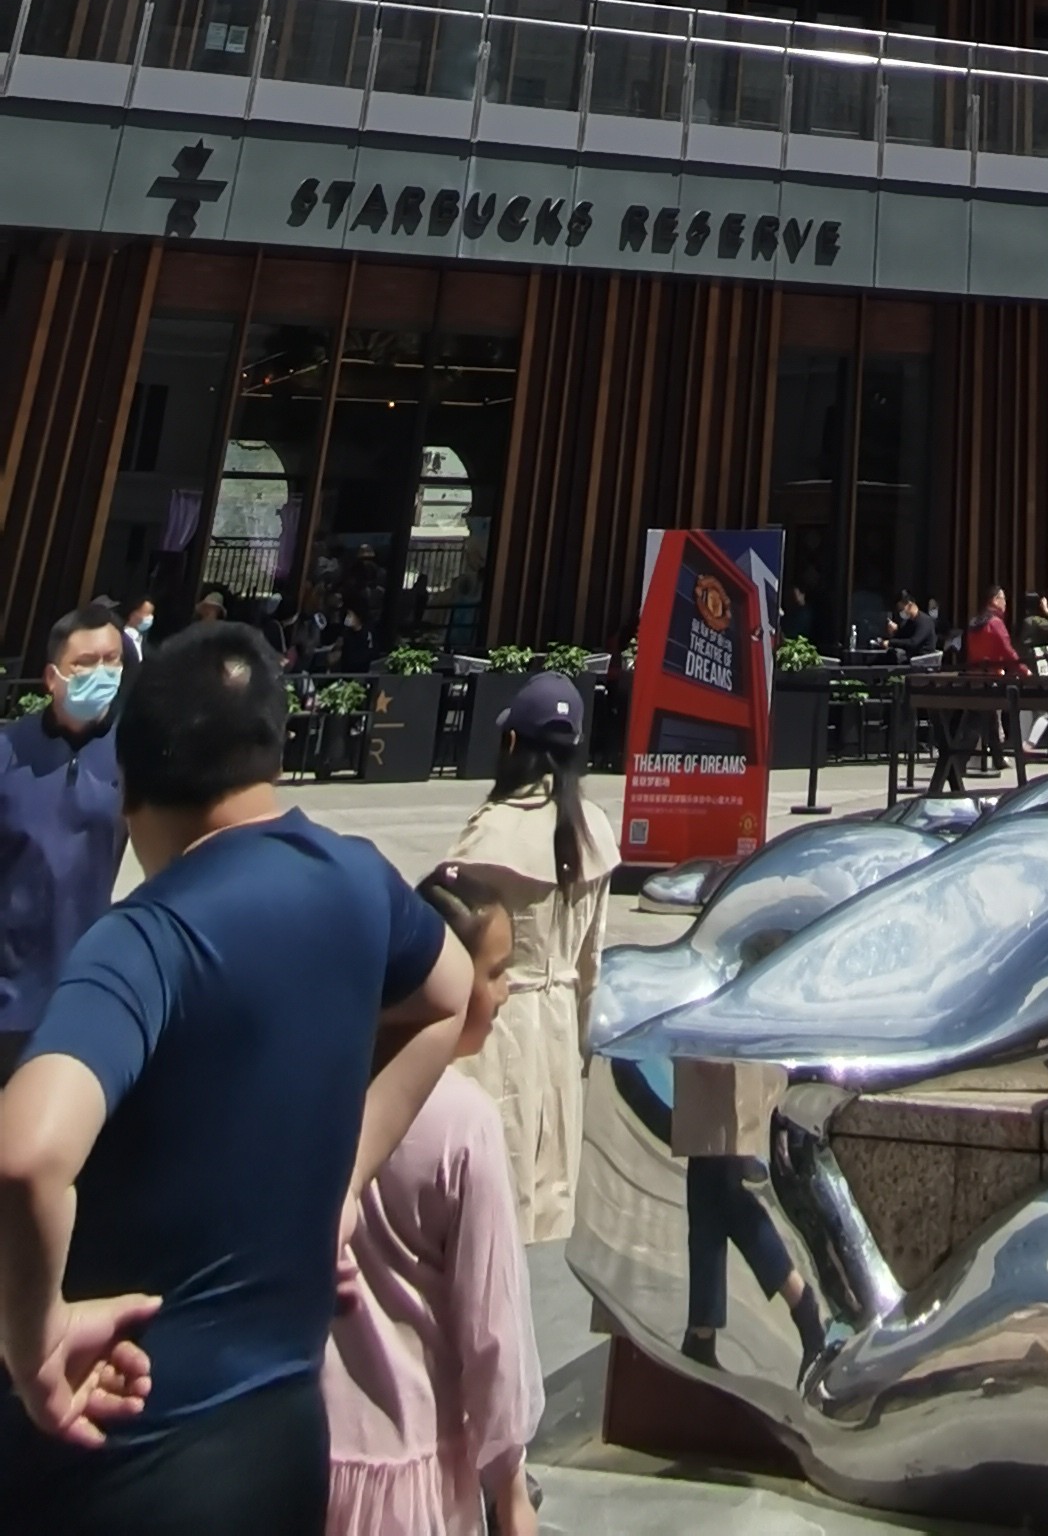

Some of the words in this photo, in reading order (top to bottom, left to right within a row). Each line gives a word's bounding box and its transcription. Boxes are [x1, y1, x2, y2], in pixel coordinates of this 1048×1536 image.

[286, 177, 594, 248] STARBUCKS
[618, 204, 842, 267] RESERVE
[689, 632, 724, 665] THEATRE
[723, 652, 733, 668] OF
[685, 650, 733, 692] DREAMS
[633, 753, 682, 773] THEATRE
[683, 754, 699, 774] OF
[700, 754, 747, 775] DREAMS
